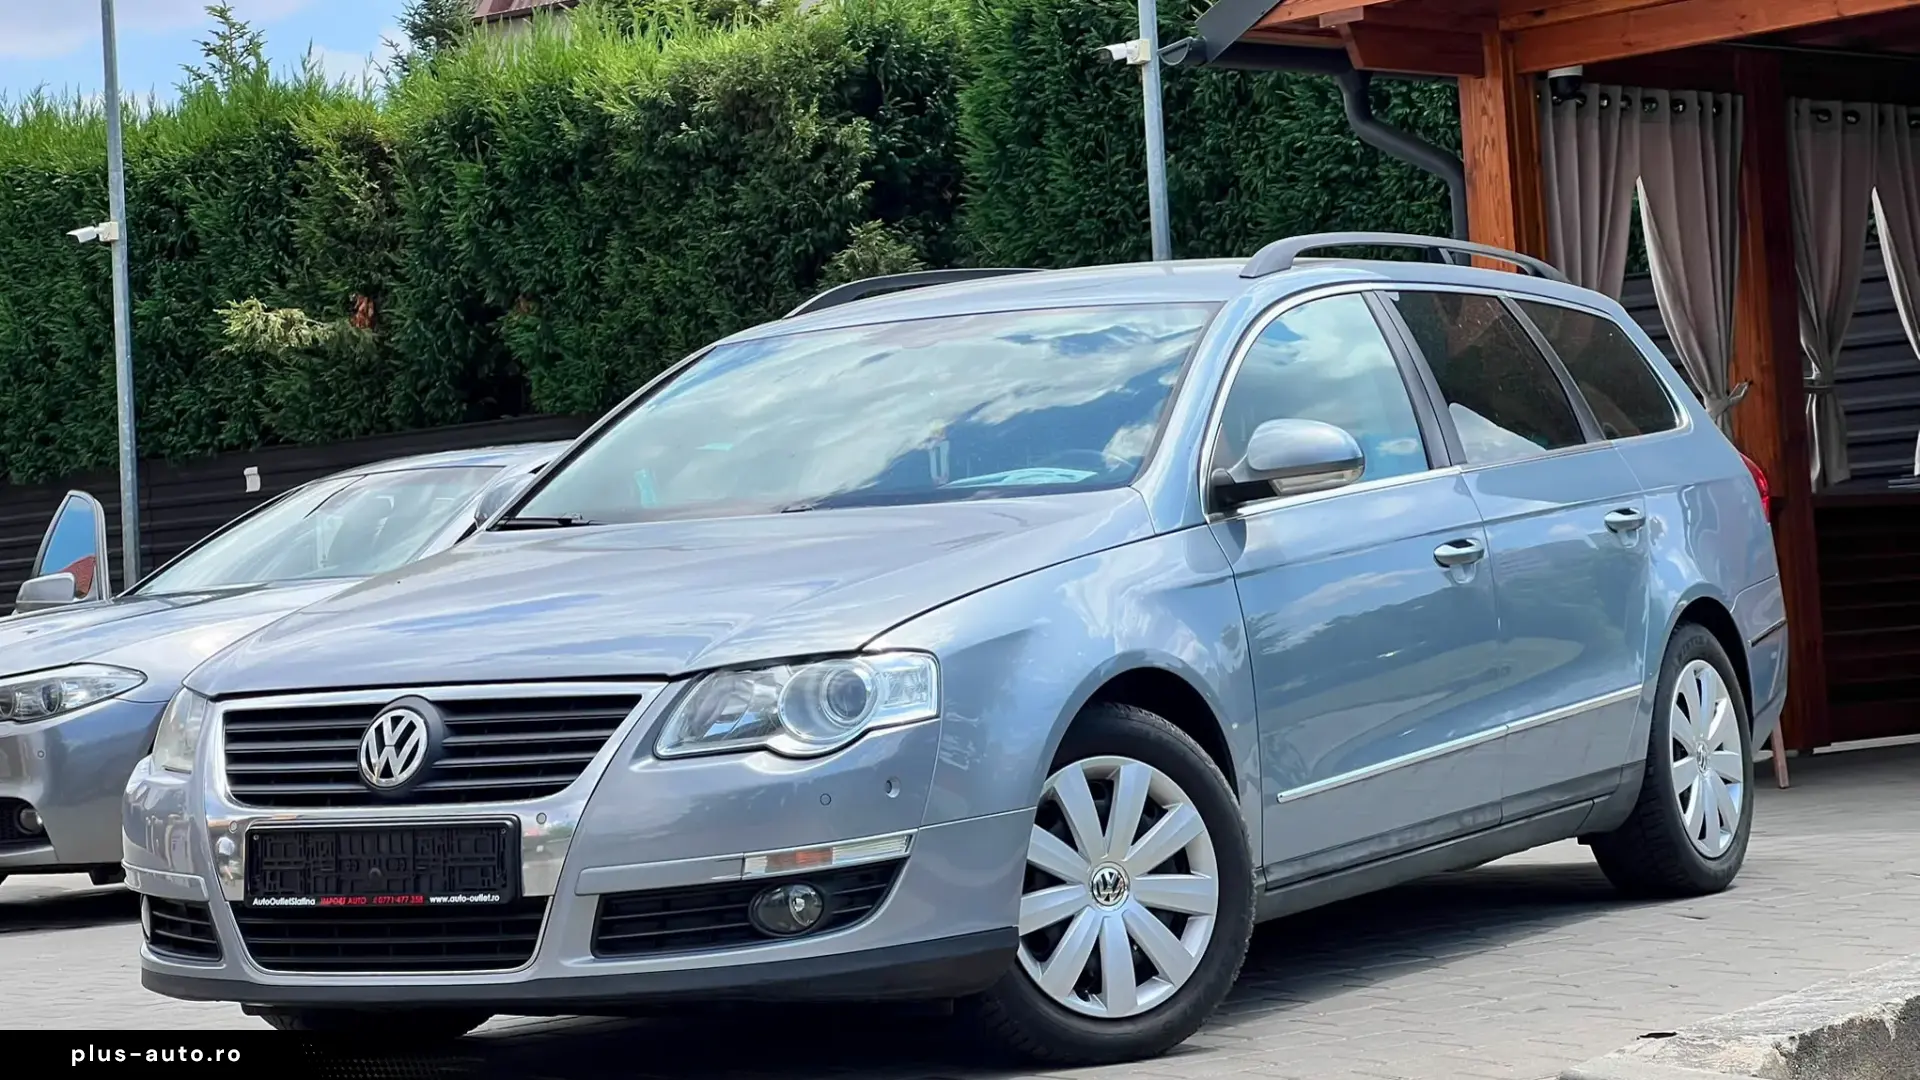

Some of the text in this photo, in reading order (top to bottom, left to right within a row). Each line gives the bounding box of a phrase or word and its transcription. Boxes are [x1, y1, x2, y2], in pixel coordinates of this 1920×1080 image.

[361, 709, 428, 787] VW
[347, 896, 367, 905] AUTO
[429, 894, 500, 904] www.auto-outlet.ro
[1092, 867, 1126, 906] VW
